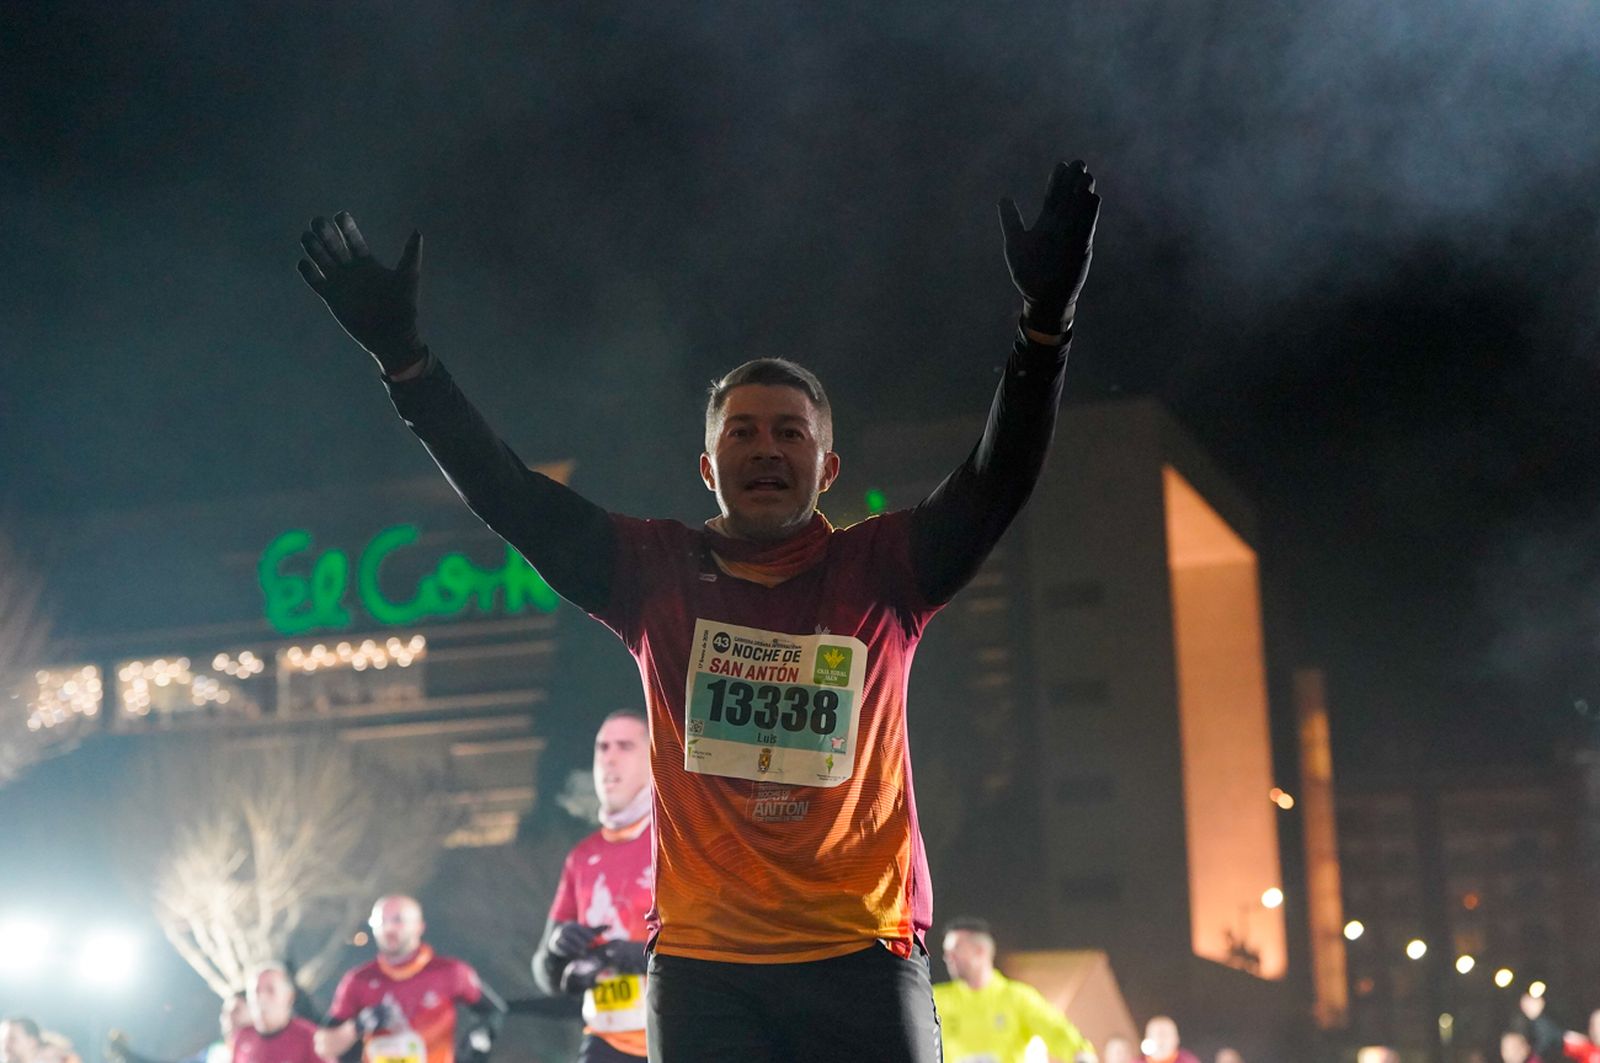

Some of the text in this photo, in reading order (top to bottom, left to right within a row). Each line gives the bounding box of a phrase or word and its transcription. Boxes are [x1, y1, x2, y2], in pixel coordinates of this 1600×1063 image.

[258, 527, 351, 635] El
[713, 635, 730, 649] 43
[732, 643, 801, 663] NOCHE DE
[709, 657, 800, 682] SAN ANTÓN
[707, 679, 839, 735] 13338
[757, 732, 778, 744] Luis
